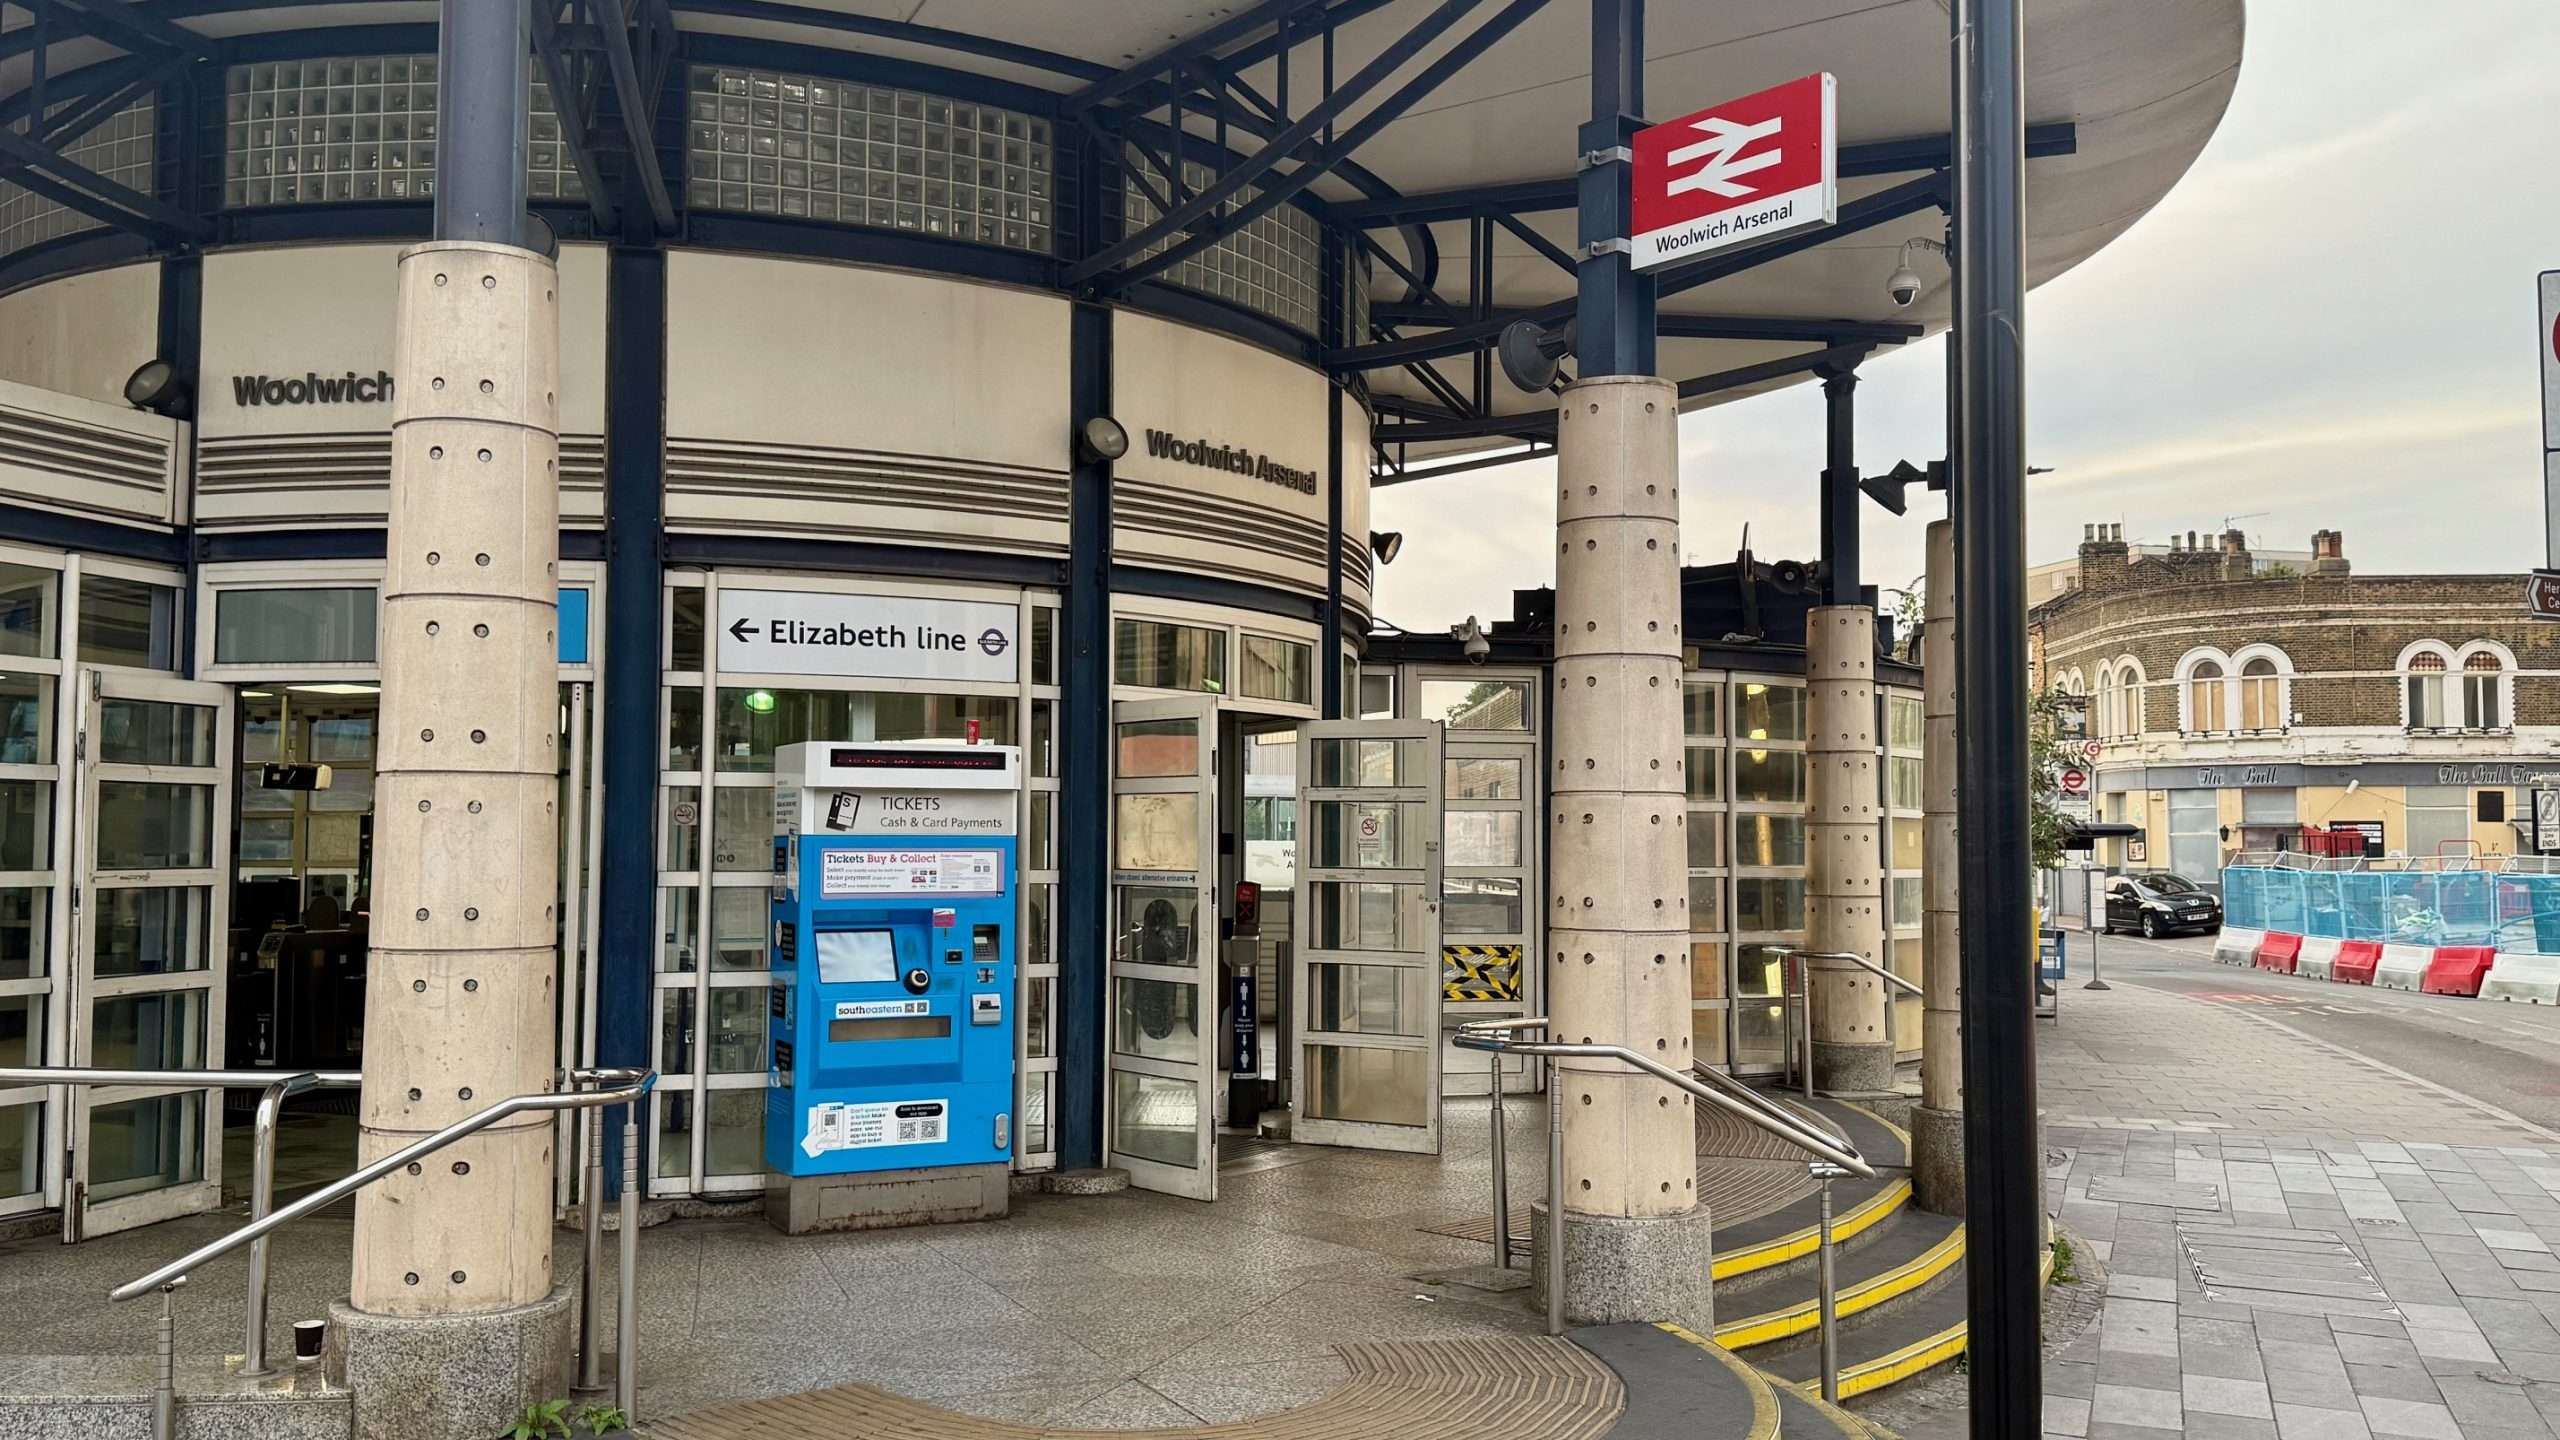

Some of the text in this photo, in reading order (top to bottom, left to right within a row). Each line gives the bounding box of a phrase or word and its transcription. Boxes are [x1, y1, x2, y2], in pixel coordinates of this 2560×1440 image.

[1655, 200, 1793, 253] Woolwich Arsenal
[232, 370, 395, 407] Woolwich
[1145, 428, 1317, 496] Woolwich Arsenal
[770, 619, 966, 651] Elizabeth line
[2241, 765, 2279, 785] Bull
[2439, 764, 2468, 784] The
[2472, 764, 2507, 784] Bull
[842, 796, 851, 807] S
[880, 796, 941, 811] TICKETS
[880, 816, 1003, 831] Cash & Card Payments
[826, 854, 936, 865] Tickets Buy & Collect
[838, 1003, 903, 1015] southeastern
